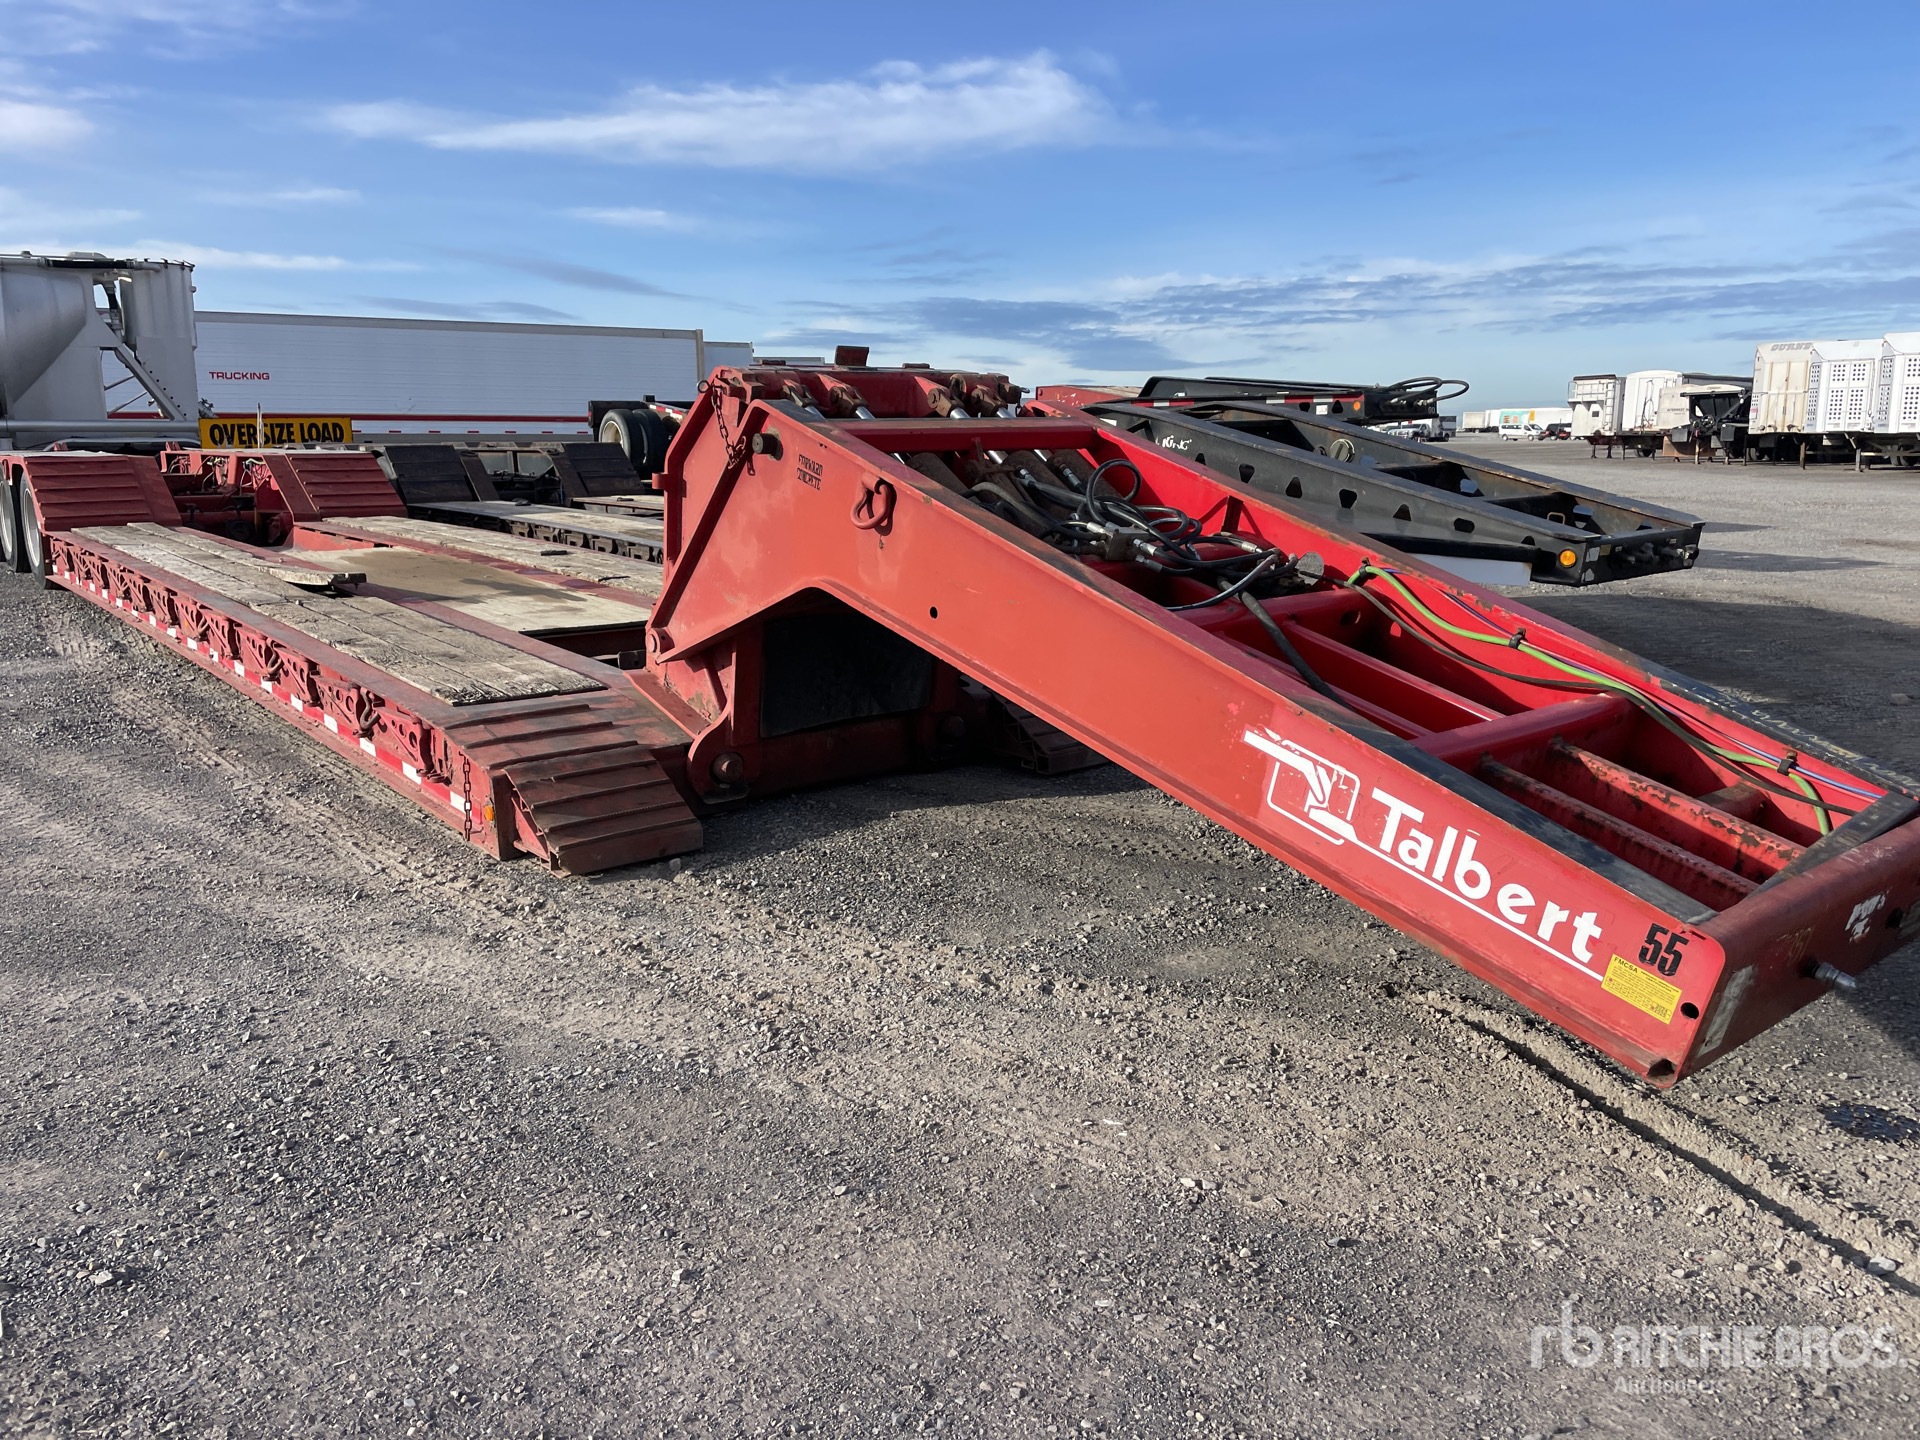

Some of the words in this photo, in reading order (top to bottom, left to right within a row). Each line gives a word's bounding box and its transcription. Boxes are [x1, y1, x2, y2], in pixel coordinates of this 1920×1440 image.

[208, 371, 270, 380] TRUCKING
[209, 423, 296, 446] OVERSIZE
[299, 422, 345, 443] LOAD
[1371, 786, 1603, 964] Talbert
[1638, 922, 1690, 977] 55
[1613, 956, 1639, 974] FMCSA
